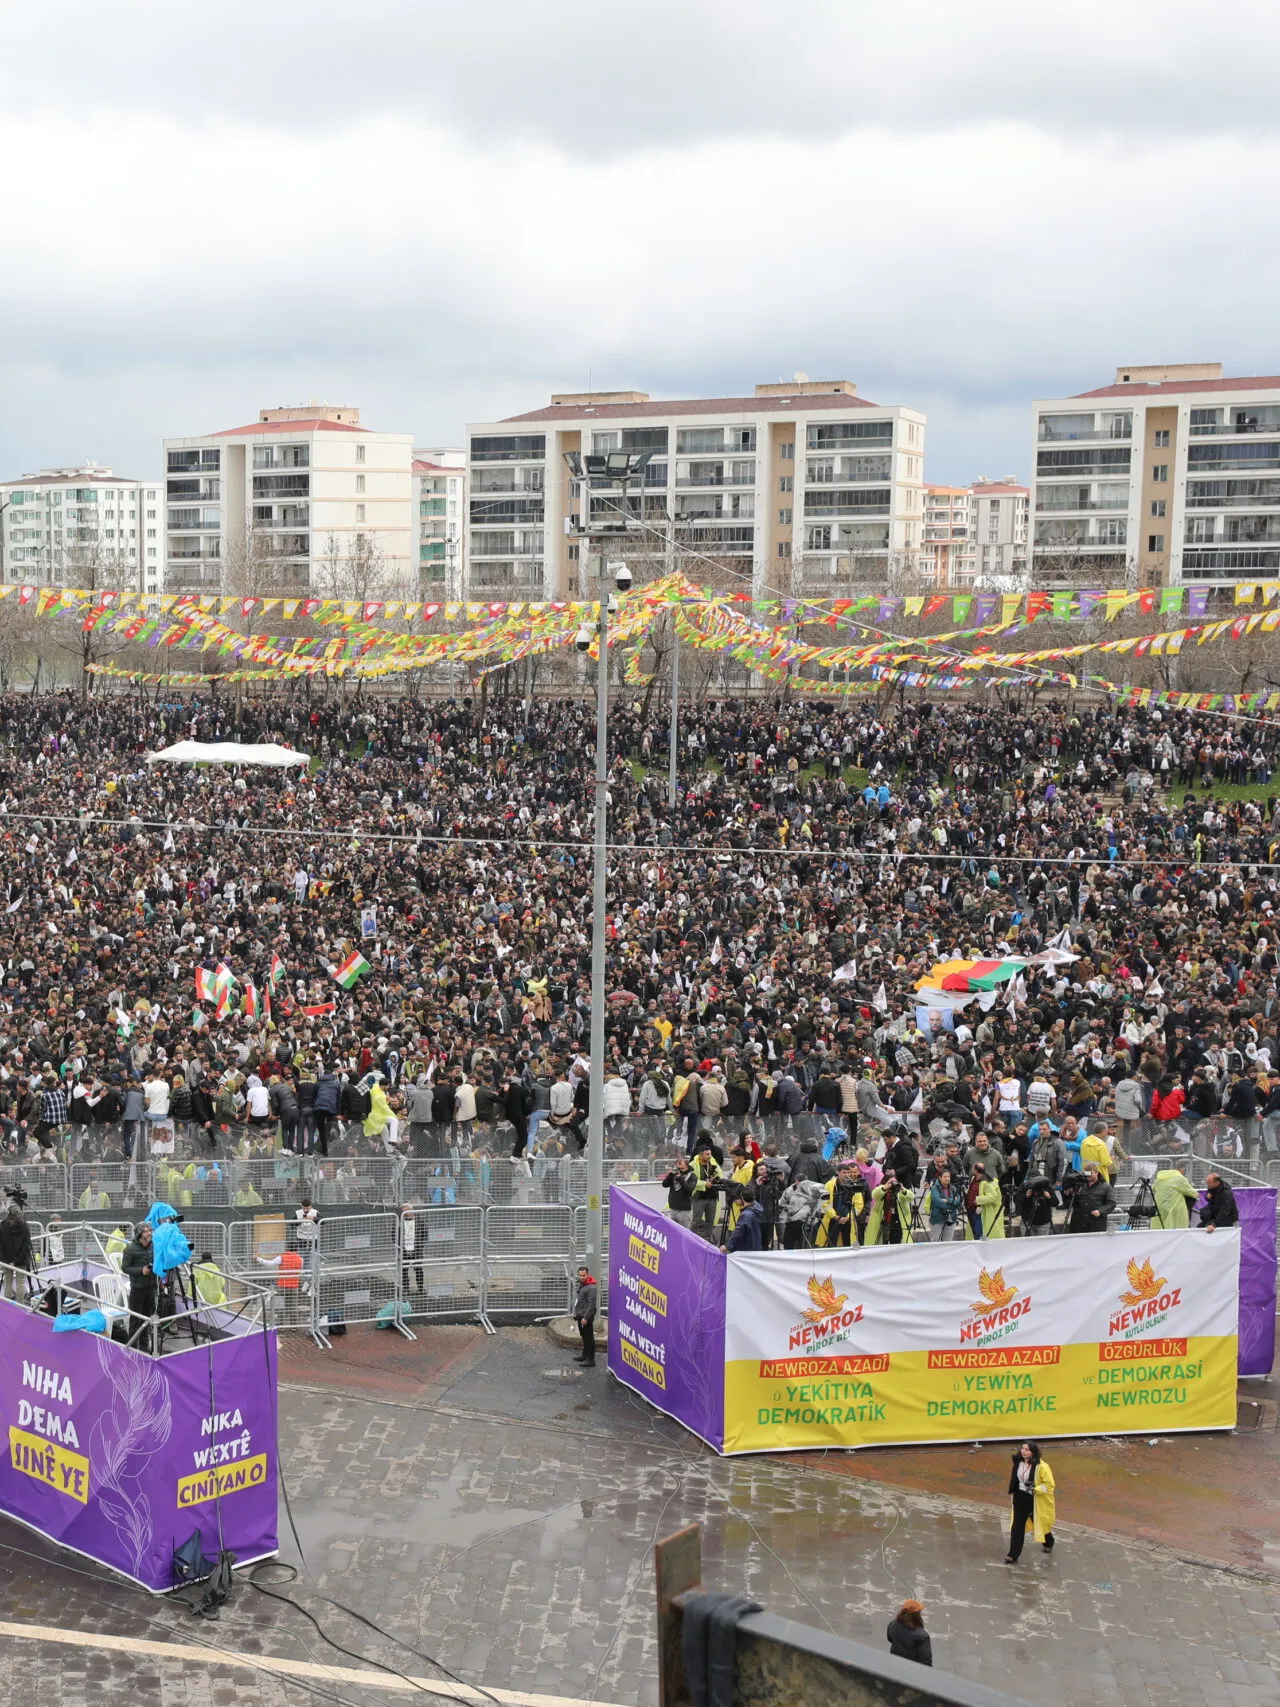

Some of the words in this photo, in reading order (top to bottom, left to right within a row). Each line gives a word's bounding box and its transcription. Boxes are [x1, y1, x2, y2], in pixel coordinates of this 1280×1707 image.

[623, 1212, 644, 1236] NIHA
[644, 1224, 667, 1251] DEMA
[630, 1243, 646, 1264] JINÊ
[647, 1252, 658, 1271] YE
[619, 1265, 639, 1294] ŞİMDİ
[640, 1284, 666, 1313] KADIN
[625, 1296, 656, 1328] ZAMANI
[960, 1296, 1032, 1344] NEWROZ
[1108, 1288, 1181, 1337] NEWROZ
[619, 1319, 637, 1344] NIKA
[638, 1333, 665, 1365] WEXTÊ
[789, 1304, 864, 1351] NEWROZ
[1125, 1323, 1144, 1339] KUTLU
[931, 1352, 1008, 1367] NEWROZA
[1012, 1347, 1057, 1365] AZADÎ
[1104, 1339, 1183, 1360] ÖZGÜRLÜK
[656, 1371, 663, 1385] O
[763, 1360, 838, 1377] NEWROZA
[843, 1355, 887, 1373] AZADÎ
[1083, 1376, 1095, 1385] VE
[1098, 1360, 1203, 1385] DEMOKRASİ
[22, 1360, 73, 1405] NIHA
[786, 1380, 873, 1402] YEKÎTIYA
[963, 1371, 1033, 1391] YEWÎYA
[927, 1394, 1057, 1417] DEMOKRATÎKE
[1097, 1388, 1187, 1408] NEWROZU
[18, 1399, 80, 1449] DEMA
[201, 1408, 243, 1437] NIKA
[758, 1401, 887, 1425] DEMOKRATÎK
[193, 1428, 251, 1470] WEXTÊ
[15, 1443, 55, 1482] JINÊ
[60, 1463, 85, 1497] YE
[180, 1468, 246, 1504] CINÎYAN
[250, 1463, 263, 1482] O
